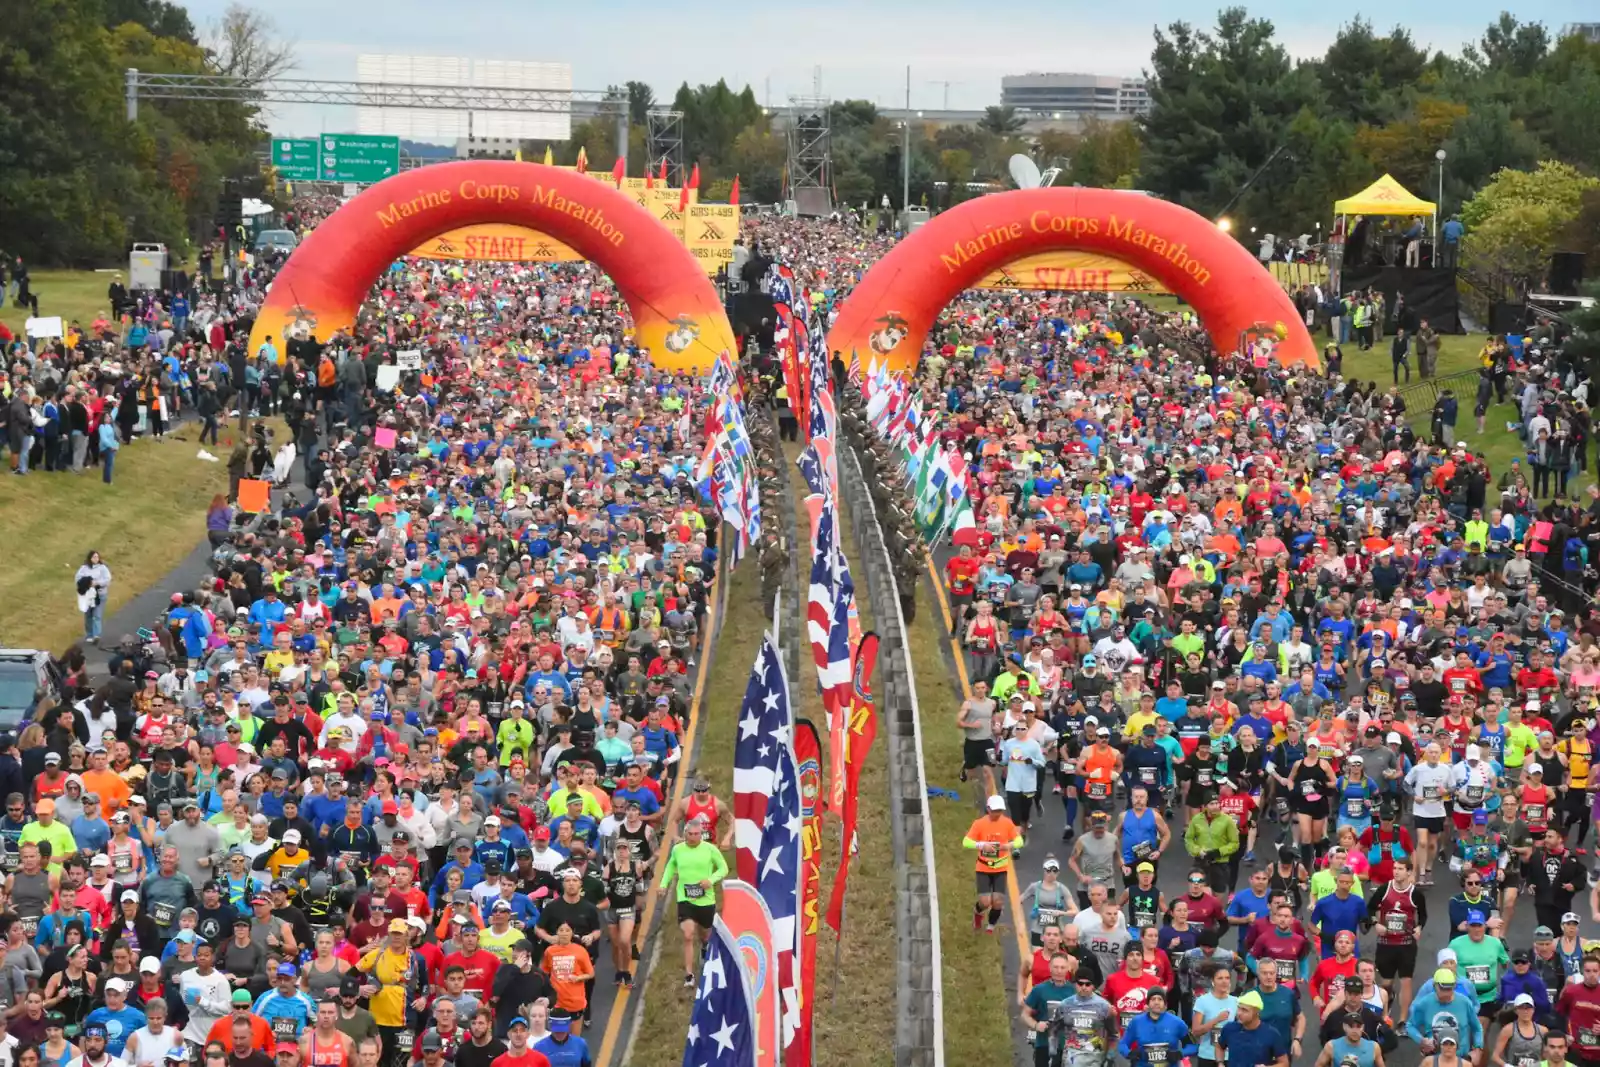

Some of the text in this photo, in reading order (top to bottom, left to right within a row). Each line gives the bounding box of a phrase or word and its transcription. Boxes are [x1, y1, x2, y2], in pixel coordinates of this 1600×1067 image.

[376, 180, 626, 248] Marine Corps Marathon
[464, 235, 527, 258] START
[939, 210, 1213, 287] Marine Corps Marathon
[1033, 266, 1113, 292] START
[1092, 941, 1120, 955] 26.2
[1148, 1051, 1167, 1061] 11762
